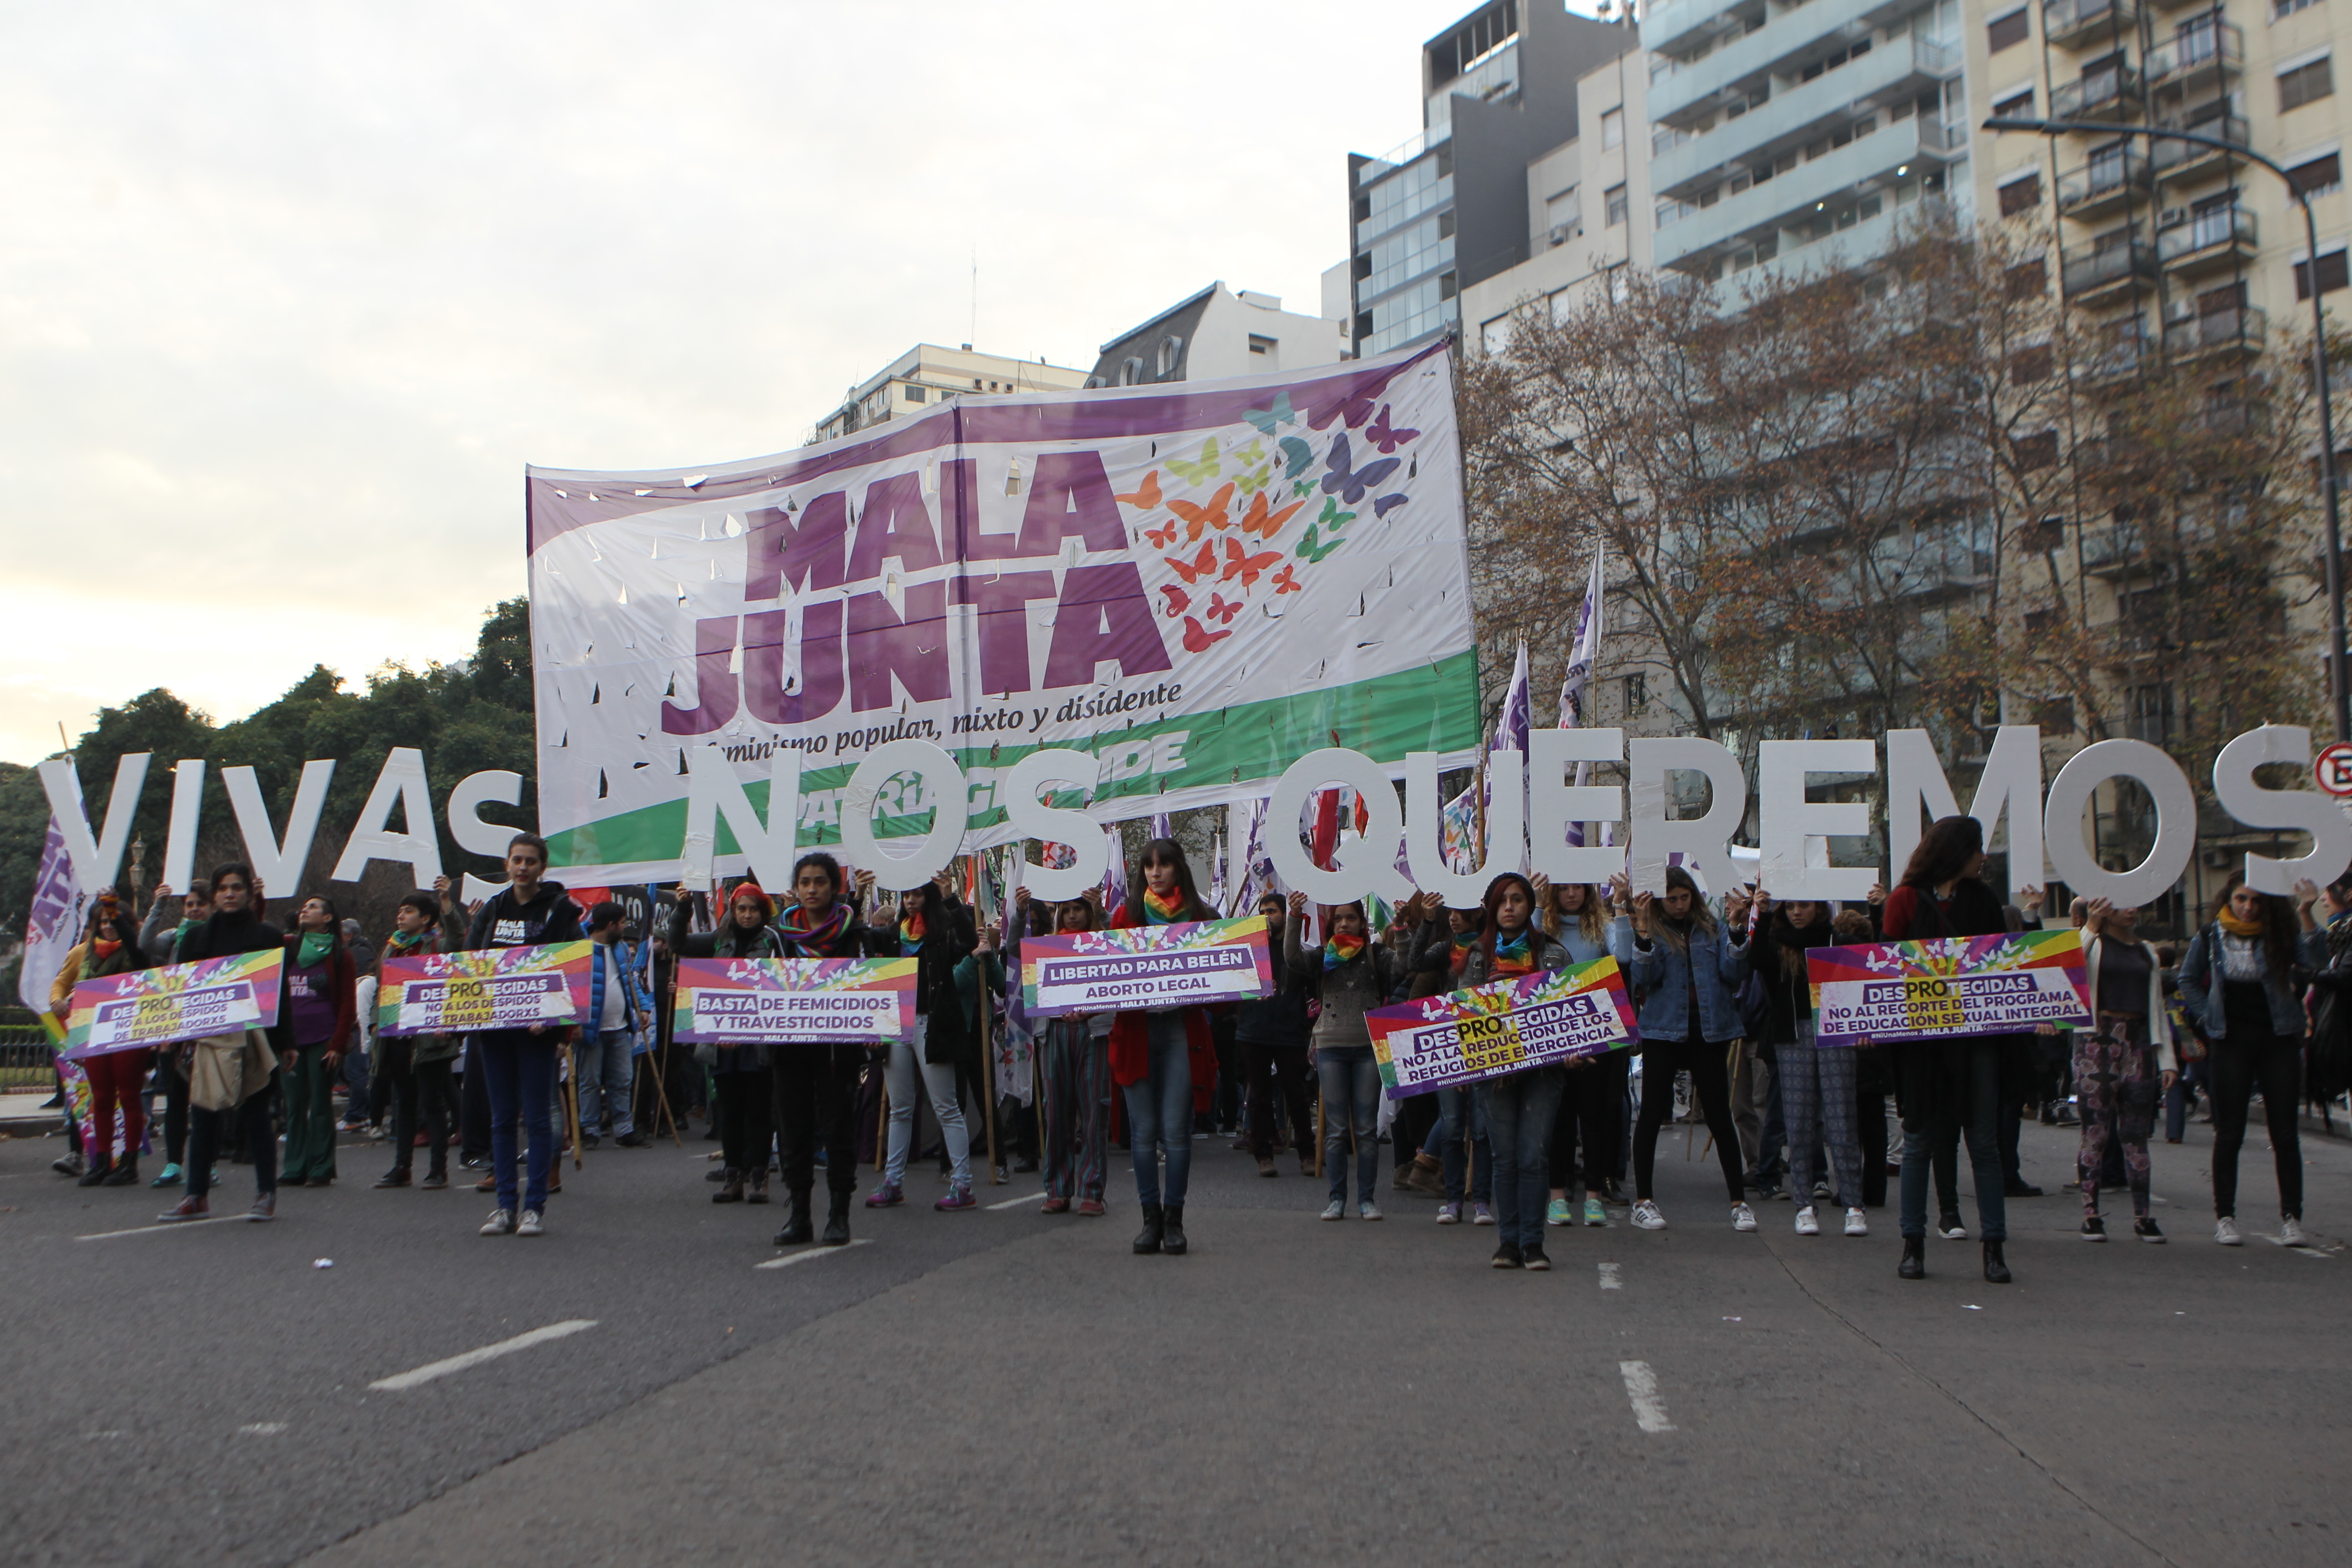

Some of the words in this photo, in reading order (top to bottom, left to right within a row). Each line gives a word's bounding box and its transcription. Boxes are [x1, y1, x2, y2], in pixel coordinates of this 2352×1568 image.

[745, 450, 1128, 601] MALA
[661, 561, 1173, 736] JUNTA
[835, 717, 942, 756] popular,
[952, 706, 1023, 734] mixto
[1029, 708, 1049, 733] y
[1056, 684, 1183, 723] disidente
[680, 738, 1109, 902] NOS
[1266, 724, 2352, 909] QUEREMOS
[1050, 962, 1133, 981] LIBERTAD
[1137, 958, 1184, 973] PARA
[1187, 950, 1242, 968] BELÉN
[420, 979, 548, 1002] DESPROTEGIDAS
[1086, 981, 1154, 999] ABORTO
[1158, 977, 1211, 992] LEGAL
[1120, 999, 1146, 1008] MALA
[1146, 997, 1177, 1006] JUNTA
[1868, 977, 2030, 1002] DESPROTEGIDAS
[111, 988, 236, 1020] DESPROTEGIDAS
[116, 1019, 132, 1029] NO
[134, 1017, 143, 1027] A
[145, 1013, 168, 1025] LOS
[170, 1004, 228, 1021] DESPIDOS
[425, 1004, 442, 1013] NO
[444, 1003, 455, 1011] A
[457, 999, 479, 1010] LOS
[481, 995, 540, 1008] DESPIDOS
[425, 1016, 442, 1025] DE
[443, 1008, 540, 1024] TRABAJADORXS
[699, 997, 757, 1011] BASTA
[760, 998, 784, 1010] DE
[788, 997, 891, 1010] FEMICIDIOS
[1824, 1021, 1845, 1033] DE
[1848, 1011, 1939, 1031] EDUCACIÓN
[1942, 1010, 2003, 1025] SEXUAL
[2006, 1004, 2082, 1020] INTEGRAL
[1829, 1008, 1851, 1020] NO
[1855, 1006, 1875, 1018] AL
[1878, 1000, 1947, 1016] RECORTE
[1949, 997, 1980, 1010] DEL
[1984, 991, 2074, 1008] PROGRAMA
[114, 1030, 130, 1041] DE
[132, 1014, 226, 1039] TRABAJADORXS
[713, 1016, 725, 1029] Y
[728, 1016, 874, 1029] TRAVESTICIDIOS
[1419, 999, 1588, 1052] DESPROTEGIDAS
[1922, 1027, 1950, 1036] MALA
[1950, 1025, 1983, 1035] JUNTA
[1402, 1054, 1426, 1069] NO
[1429, 1052, 1443, 1066] A
[1443, 1046, 1463, 1062] LA
[1467, 1024, 1556, 1054] REDUCCION
[1558, 1020, 1580, 1034] DE
[1583, 1011, 1613, 1028] LOS
[1409, 1056, 1486, 1082] REFUGIOS
[1488, 1050, 1511, 1064] DE
[1512, 1025, 1616, 1059] EMERGENCIA
[1436, 1072, 1482, 1087] #NiUnaMenos
[1485, 1064, 1511, 1077] MALA
[1512, 1057, 1544, 1071] JUNTA
